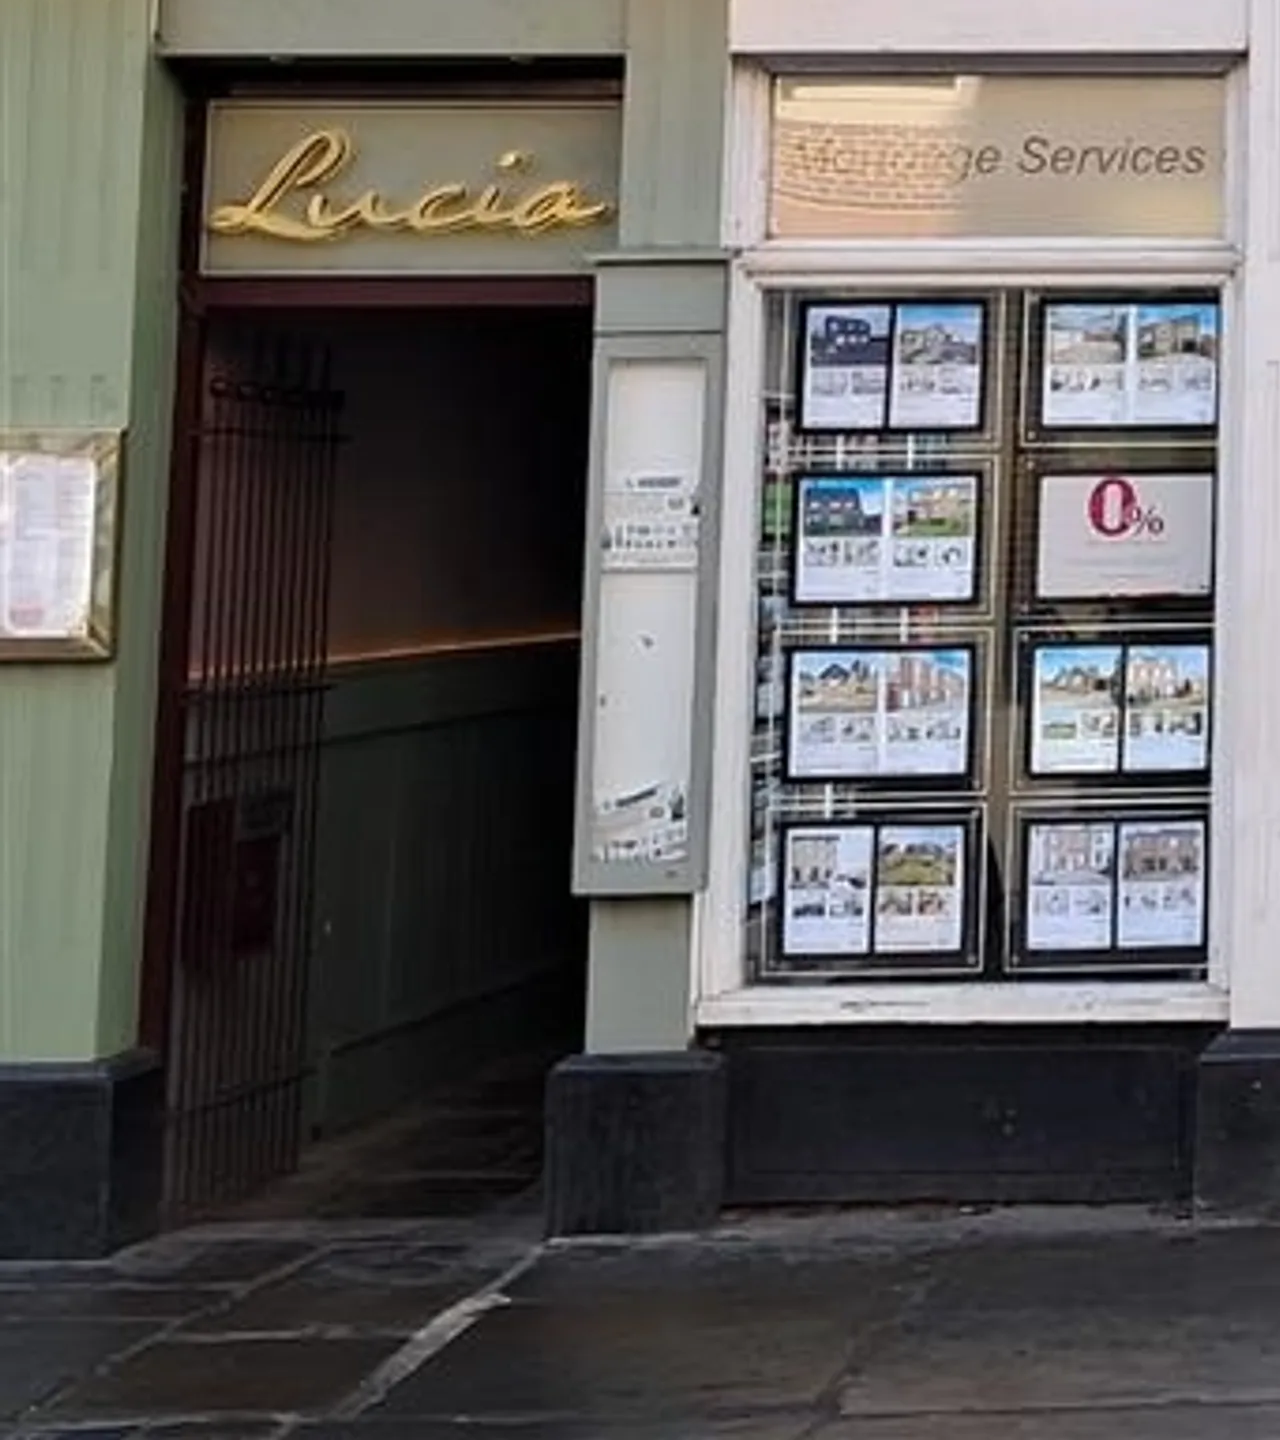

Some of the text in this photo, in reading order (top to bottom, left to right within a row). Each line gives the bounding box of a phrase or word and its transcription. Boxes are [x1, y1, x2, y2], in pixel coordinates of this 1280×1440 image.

[1018, 135, 1207, 175] Services
[208, 128, 610, 243] Lucia
[1088, 478, 1165, 537] 0%
